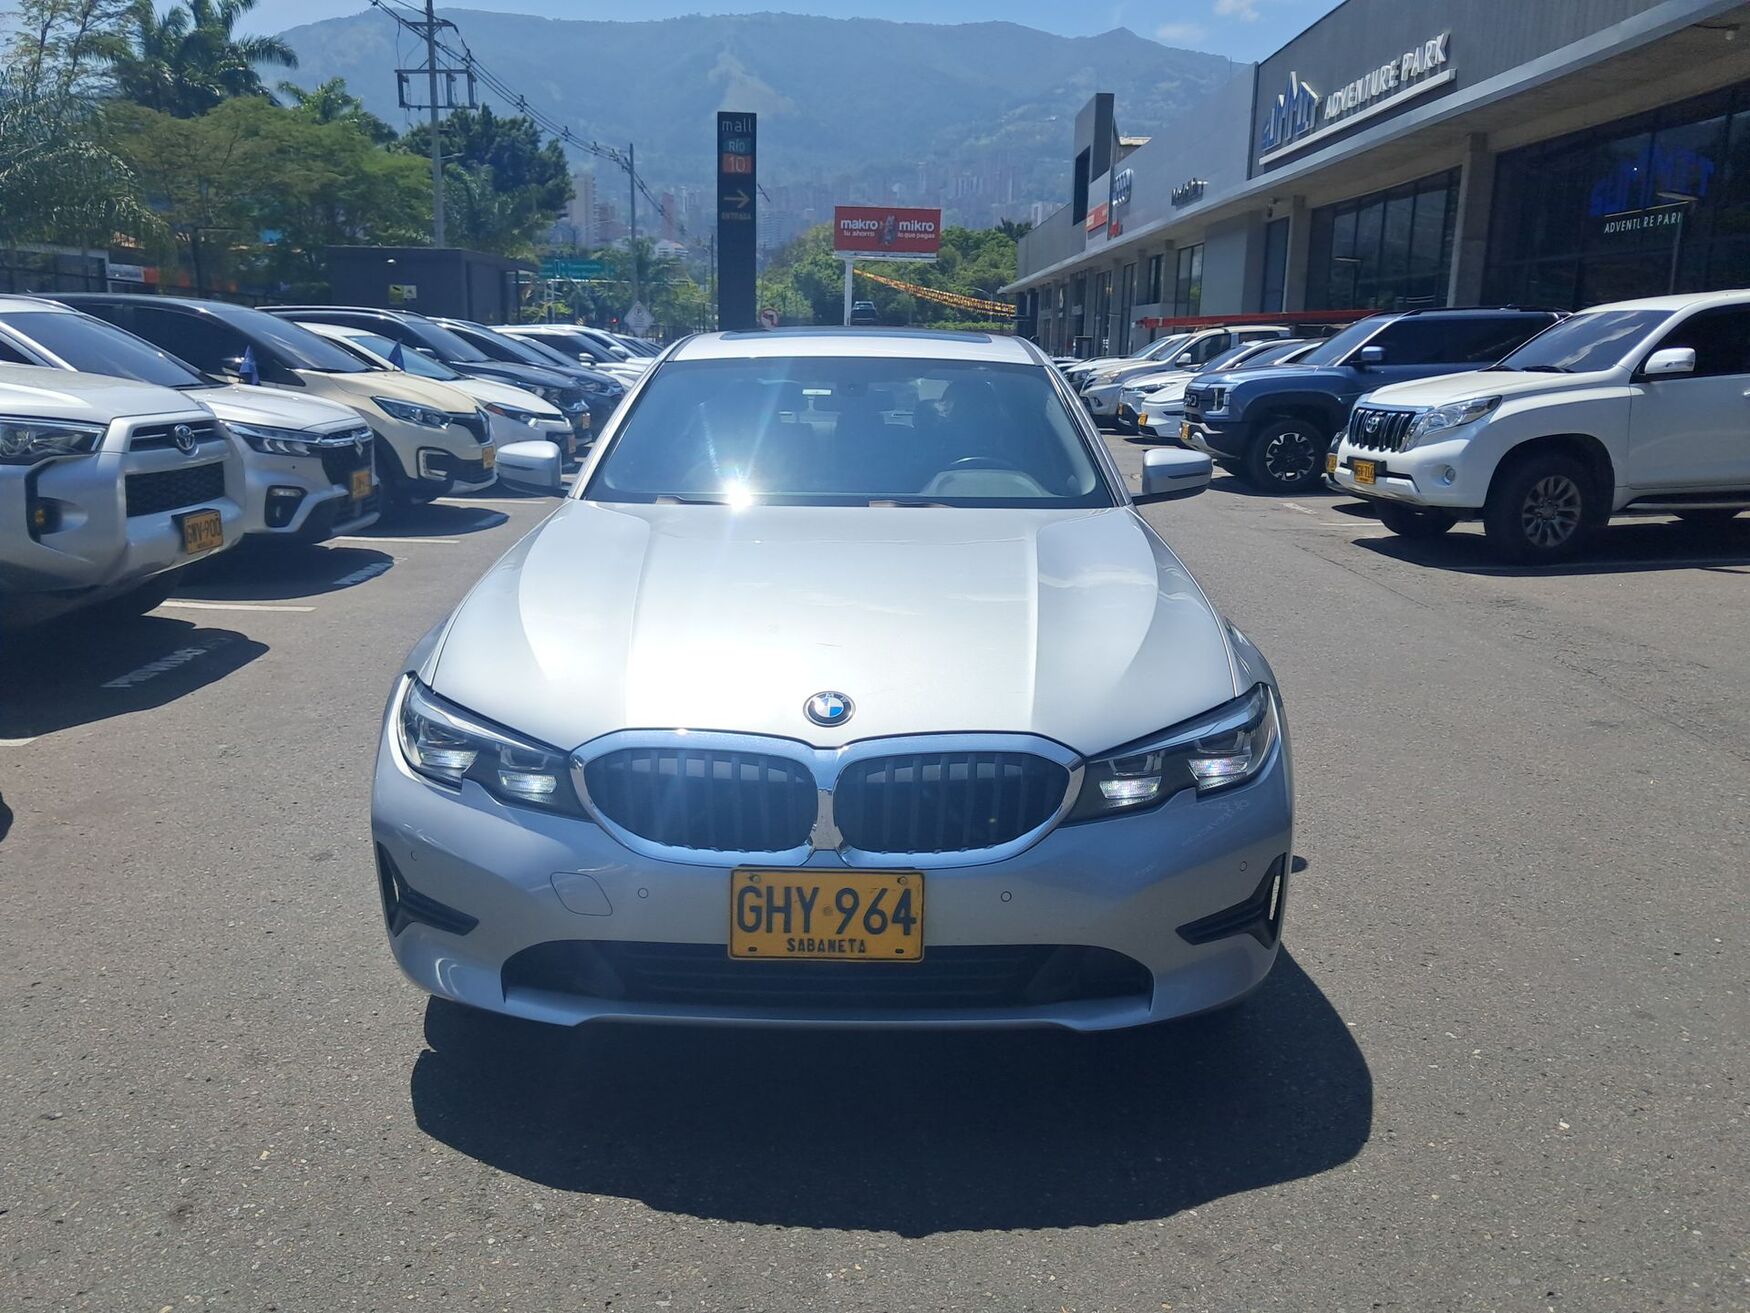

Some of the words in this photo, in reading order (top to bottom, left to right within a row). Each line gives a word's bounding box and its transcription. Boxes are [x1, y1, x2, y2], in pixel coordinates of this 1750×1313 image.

[1324, 59, 1399, 120] ADVENTURE
[1401, 32, 1450, 82] PARK
[721, 117, 752, 133] mall
[730, 156, 746, 172] 10
[840, 218, 879, 230] makro
[899, 219, 935, 231] mikro
[736, 885, 820, 934] GHY
[835, 887, 917, 936] 964
[786, 937, 867, 953] SABANETA
